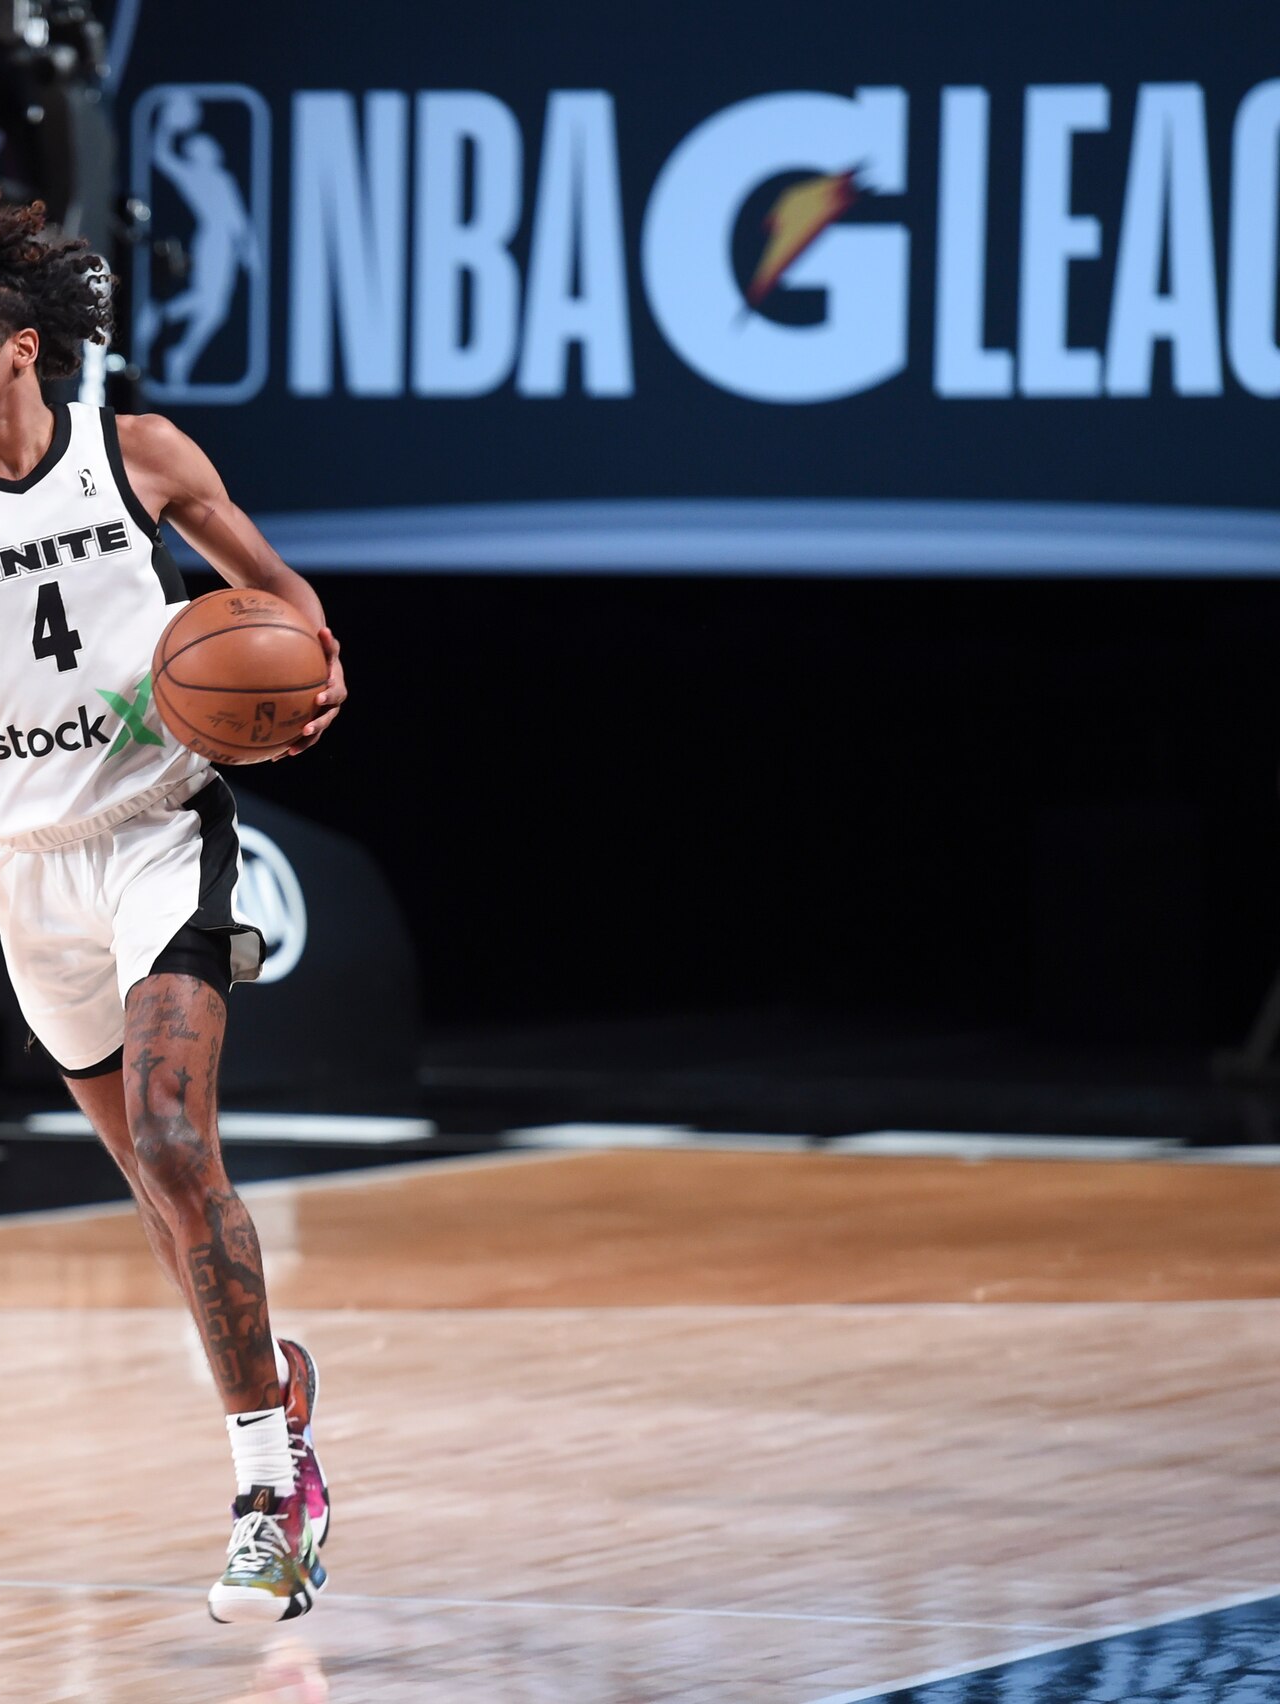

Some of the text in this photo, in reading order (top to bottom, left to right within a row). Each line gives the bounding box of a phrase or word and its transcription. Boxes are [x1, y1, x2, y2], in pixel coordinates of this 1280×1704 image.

[288, 89, 635, 399] NBA
[640, 85, 911, 404] G
[32, 581, 82, 672] 4
